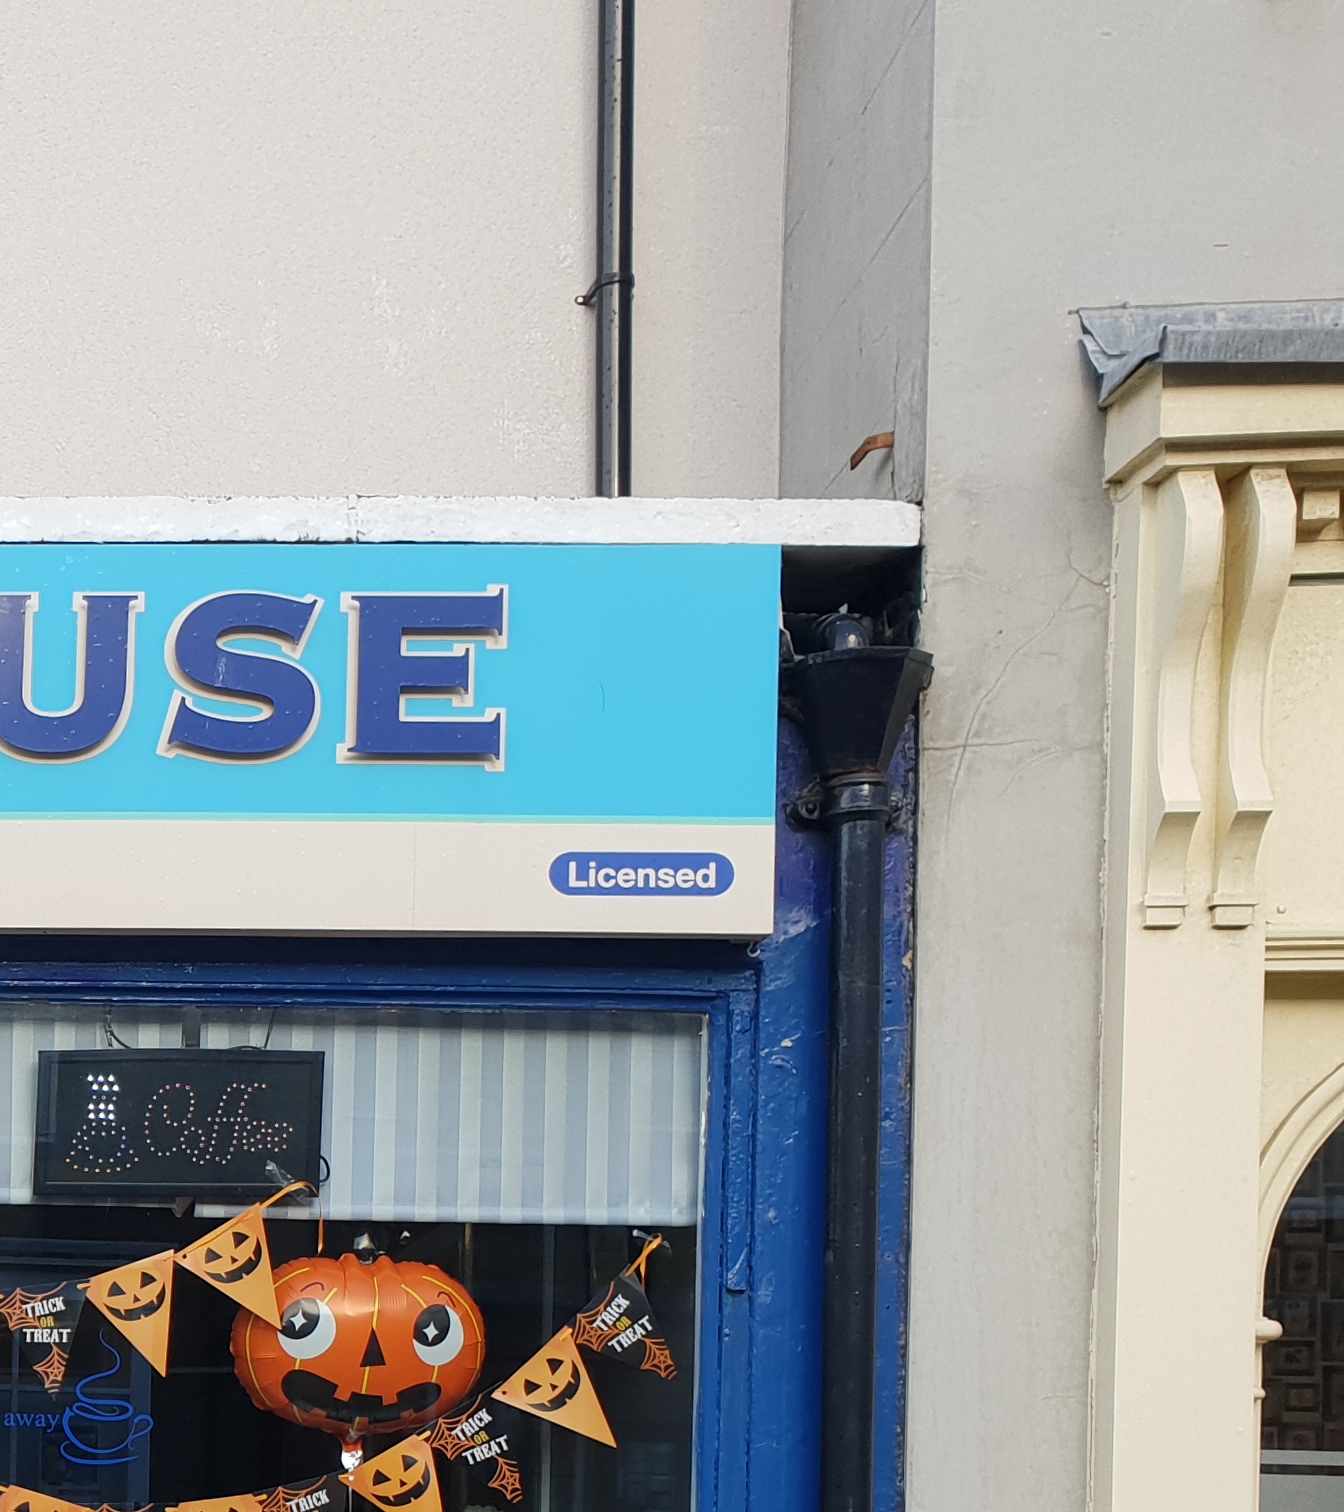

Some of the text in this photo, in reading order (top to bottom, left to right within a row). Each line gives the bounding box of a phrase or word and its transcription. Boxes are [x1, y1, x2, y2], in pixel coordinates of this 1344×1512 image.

[565, 857, 718, 893] Licensed
[144, 1083, 297, 1166] Coffee
[23, 1297, 65, 1319] TRICK
[592, 1293, 631, 1331] TRICK
[39, 1314, 55, 1328] OR
[614, 1318, 631, 1332] OR
[22, 1327, 71, 1344] TREAT
[606, 1315, 653, 1353] TREAT
[4, 1412, 61, 1433] away
[451, 1407, 493, 1442] TRICK
[461, 1436, 510, 1464] TREAT
[473, 1429, 489, 1446] OR
